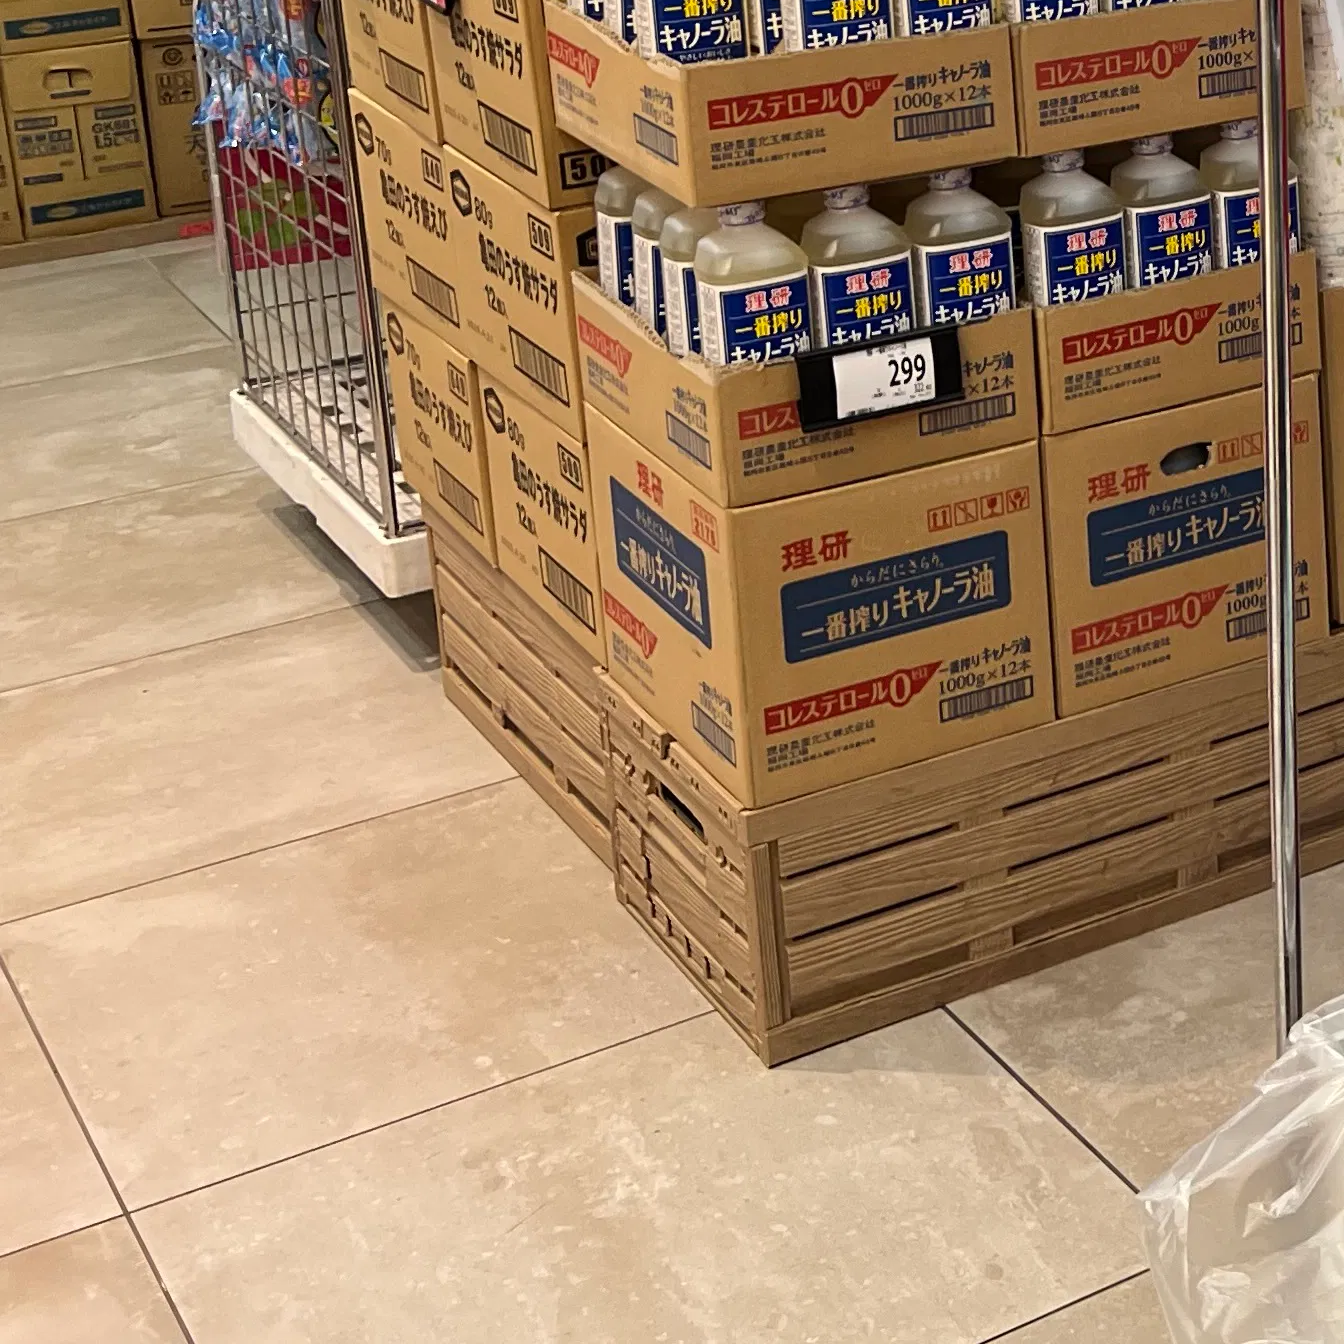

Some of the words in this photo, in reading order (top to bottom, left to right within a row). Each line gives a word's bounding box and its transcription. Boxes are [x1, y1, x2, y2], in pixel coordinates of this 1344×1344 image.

[659, 15, 741, 52] キャノーラ油
[893, 62, 991, 91] 一番搾りキャノーラ油
[893, 86, 991, 111] 1000g×12本
[1158, 208, 1197, 232] 理研
[1067, 228, 1108, 253] 理研
[1149, 230, 1206, 256] 一番搾り
[948, 249, 992, 273] 理研
[1057, 248, 1117, 277] 一番搾り
[1145, 253, 1212, 286] キャノーラ油
[846, 269, 891, 294] 理研
[939, 270, 1003, 297] 一番搾り
[1053, 274, 1124, 305] キャノーラ油
[745, 286, 792, 312] 理研
[836, 290, 902, 319] 一番搾り
[736, 308, 803, 339] 一番搾り
[888, 354, 926, 387] 299
[1088, 462, 1151, 503] 理研
[781, 530, 852, 572] 理研
[801, 562, 995, 643] 一番搾りキャノーラ油
[938, 659, 1032, 695] 1000g×12本
